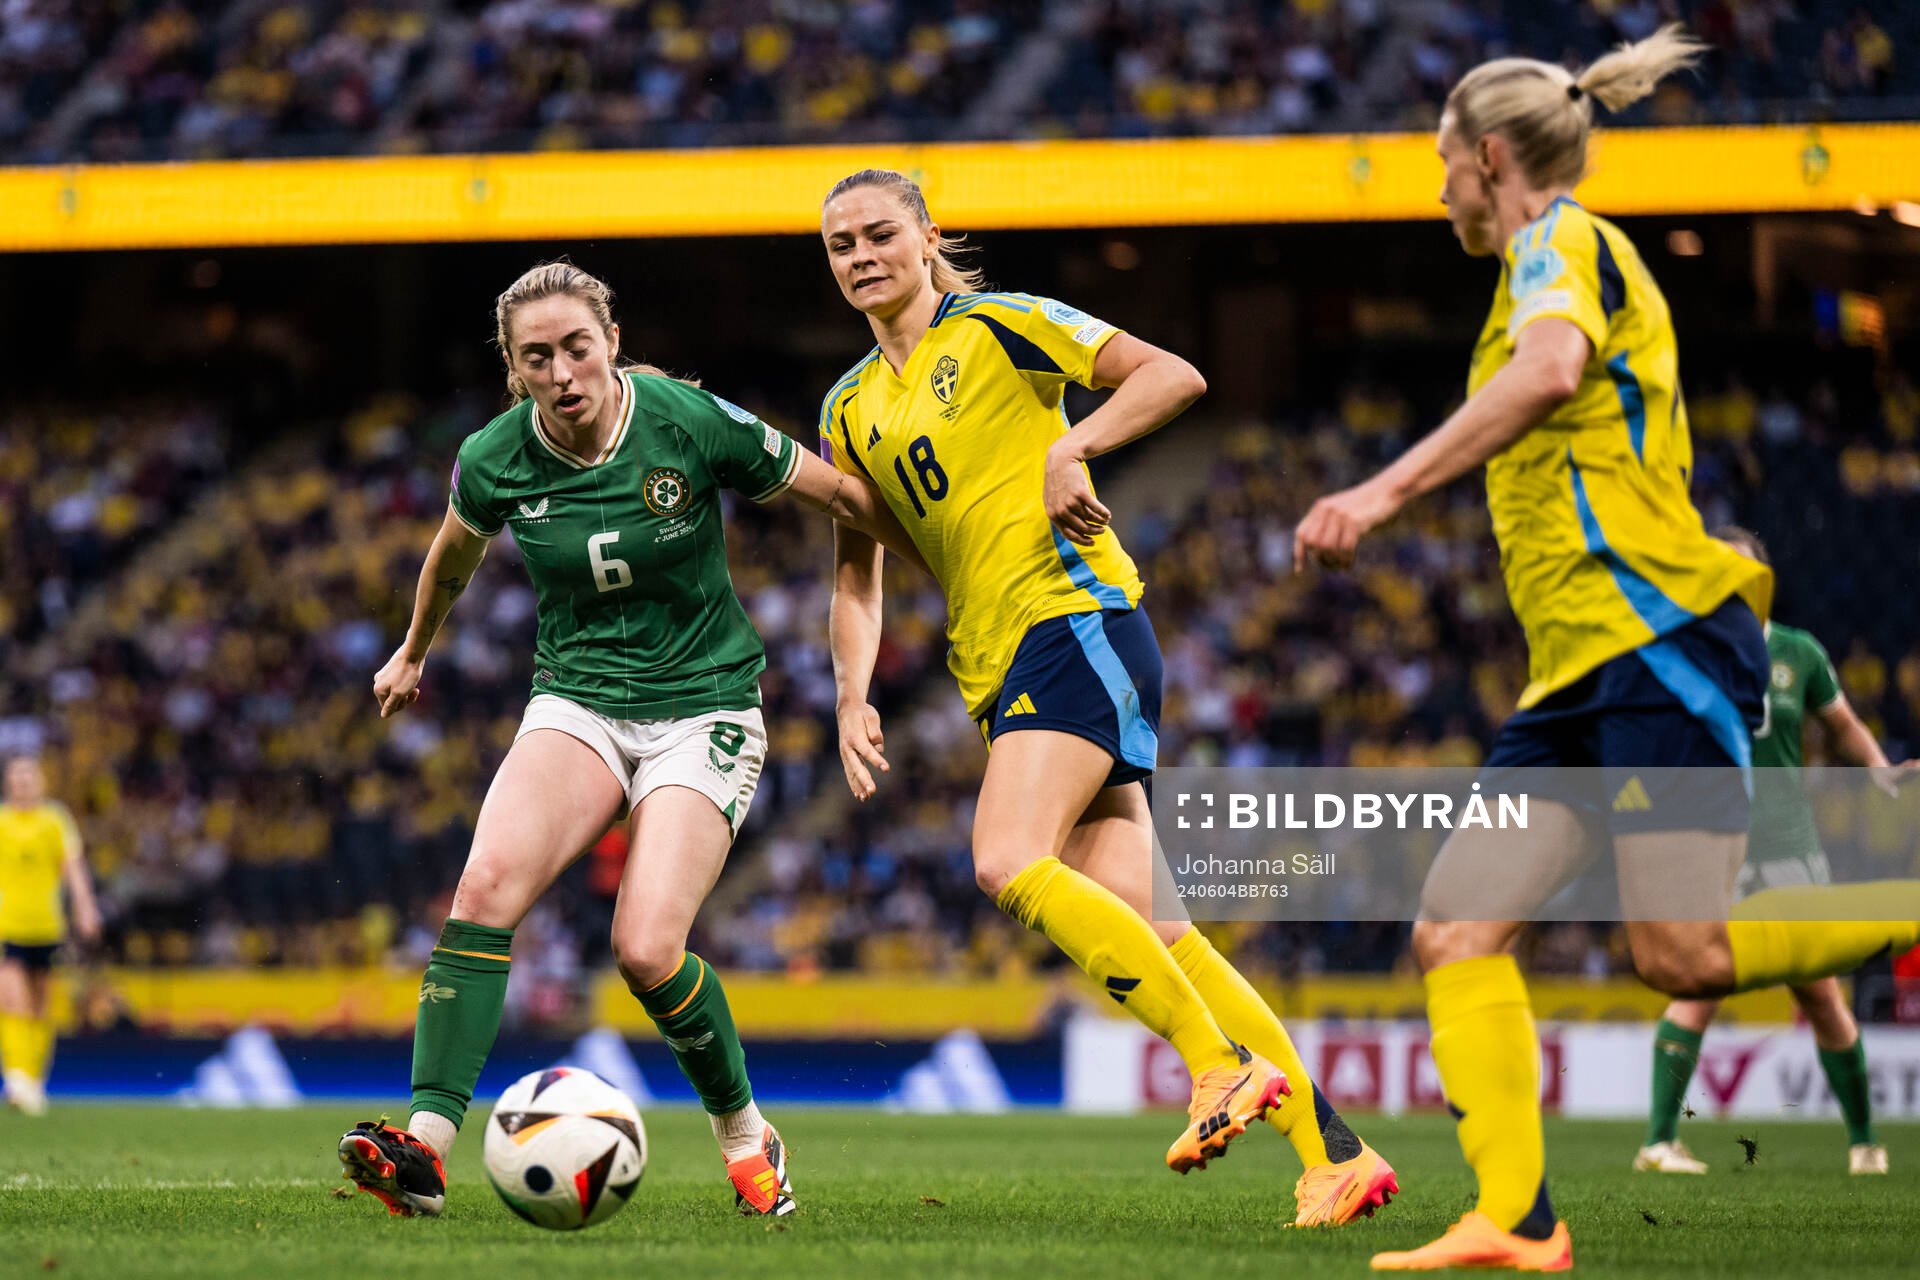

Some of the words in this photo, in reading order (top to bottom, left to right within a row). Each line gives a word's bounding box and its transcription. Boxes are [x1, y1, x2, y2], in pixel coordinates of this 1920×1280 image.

[647, 471, 684, 489] IRELAND
[894, 435, 949, 519] 18
[659, 520, 686, 535] SWEDEN
[662, 531, 679, 542] JUNE
[588, 530, 633, 593] 6
